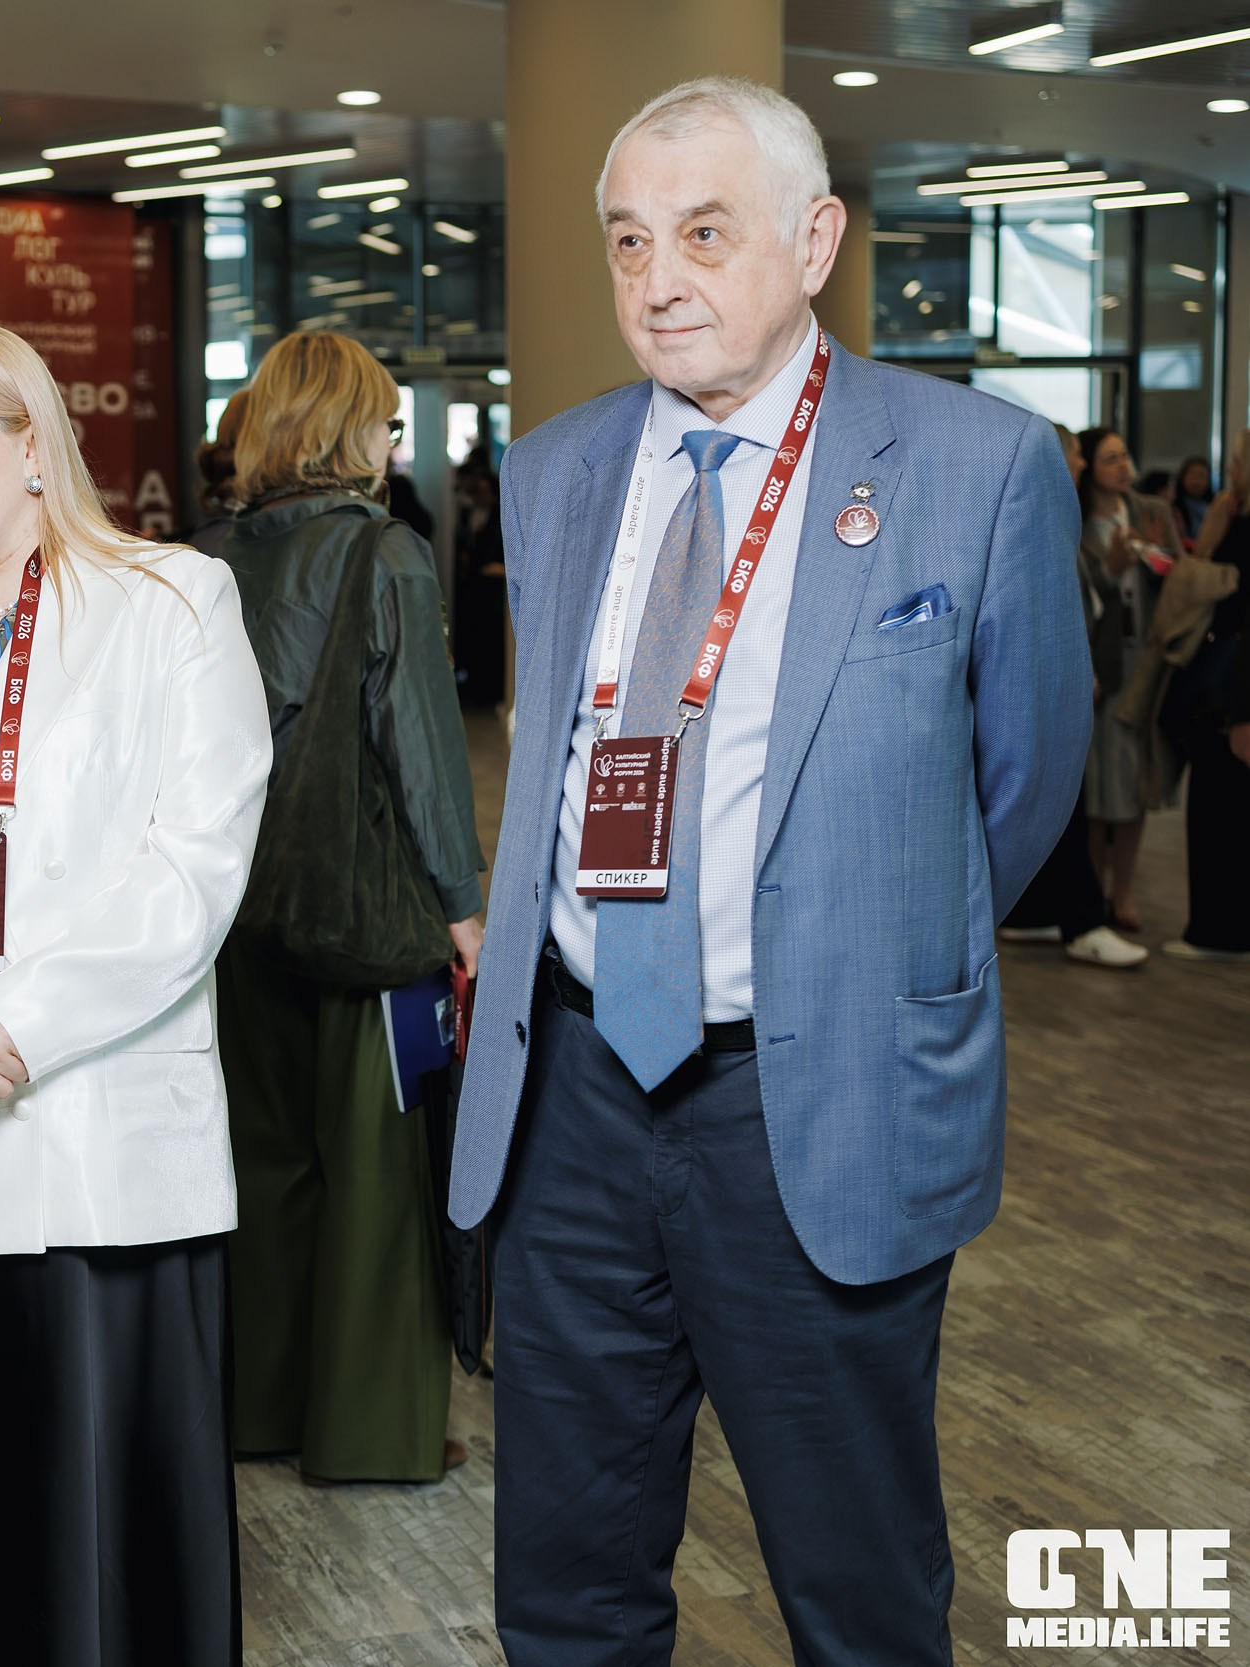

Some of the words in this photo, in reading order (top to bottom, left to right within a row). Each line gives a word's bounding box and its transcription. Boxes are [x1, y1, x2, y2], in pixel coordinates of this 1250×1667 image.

[793, 398, 814, 432] БКФ
[627, 506, 641, 539] sapere
[634, 475, 646, 503] aude
[760, 477, 785, 512] 2026
[730, 558, 753, 595] БКФ
[613, 585, 624, 613] aude
[17, 613, 33, 640] 2026
[607, 615, 621, 651] sapere
[697, 643, 721, 679] БКФ
[9, 678, 24, 705] БКФ
[0, 750, 15, 781] БКФ
[660, 737, 671, 772] sapere
[657, 774, 667, 800] aude
[653, 802, 664, 837] sapere
[650, 839, 660, 865] aude
[595, 873, 648, 884] СПИКЕР
